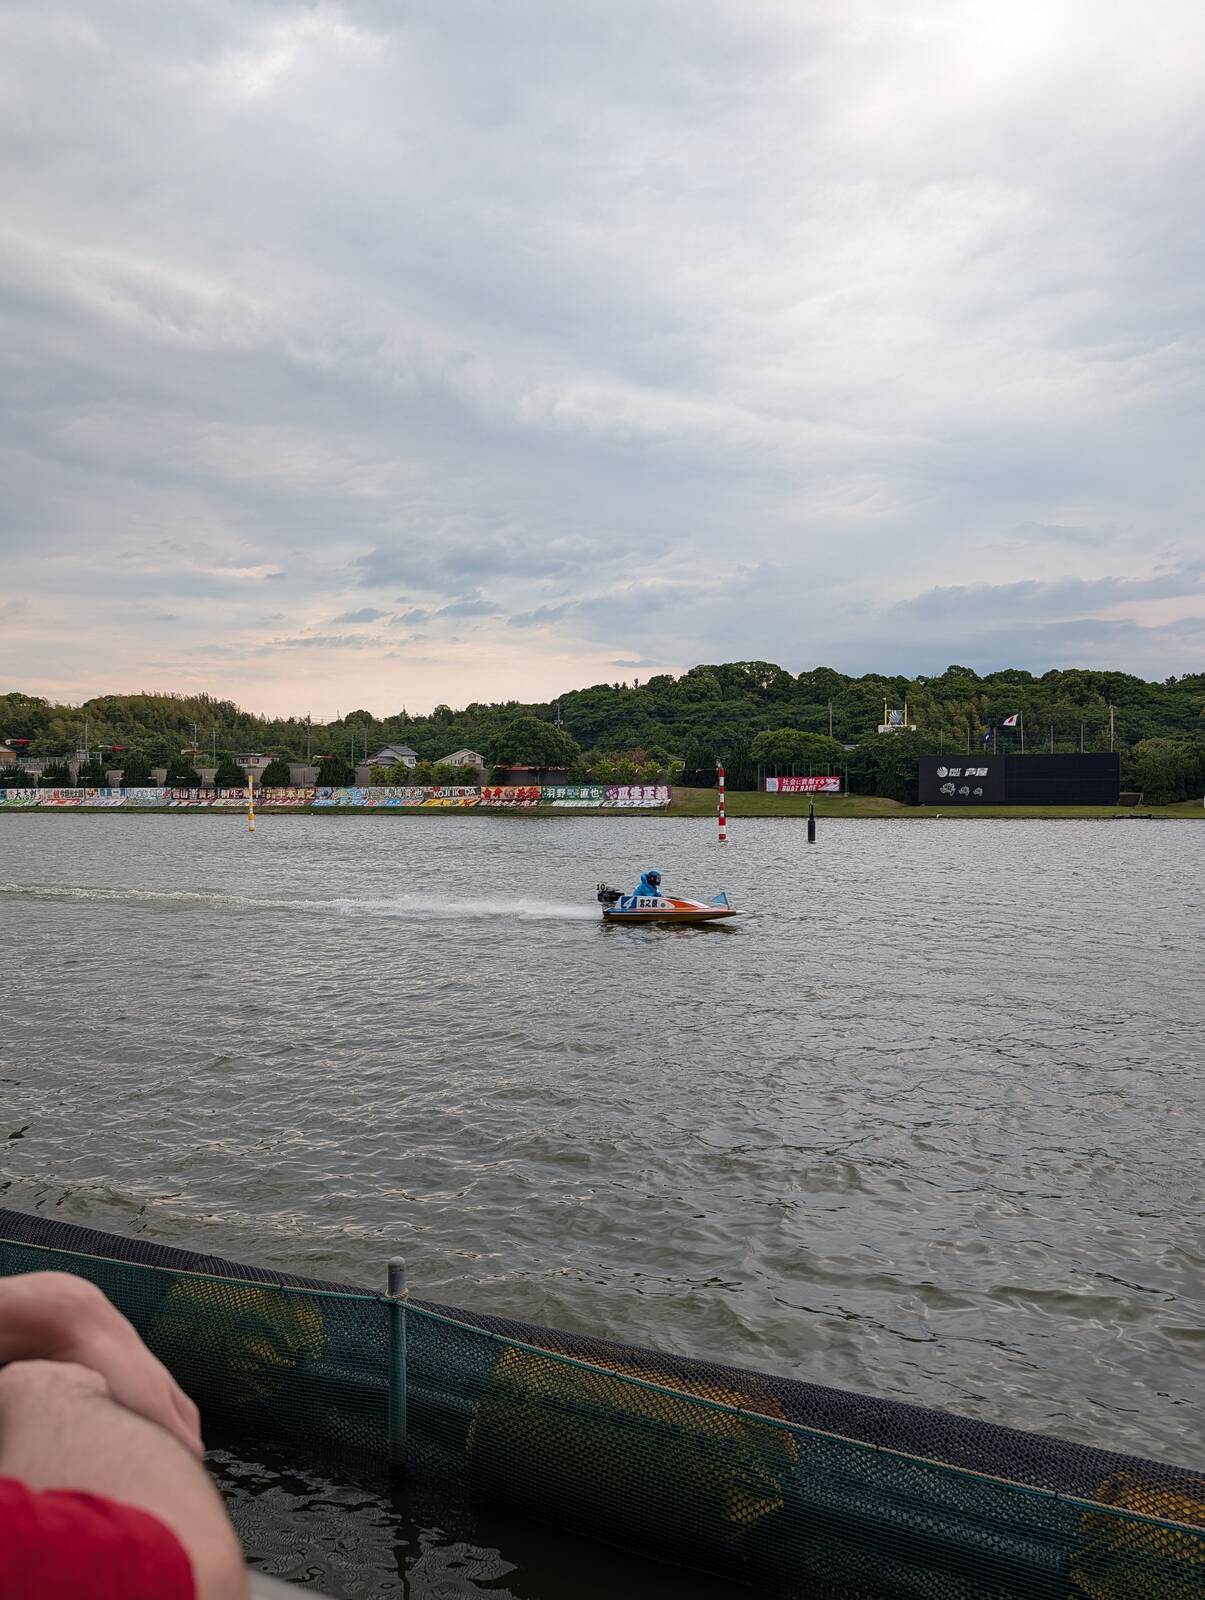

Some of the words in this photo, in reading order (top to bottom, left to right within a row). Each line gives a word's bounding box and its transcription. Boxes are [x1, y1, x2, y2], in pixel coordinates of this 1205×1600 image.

[278, 788, 315, 799] 平本真之
[433, 788, 450, 798] KOJI
[596, 883, 606, 891] 10
[623, 896, 635, 909] 4
